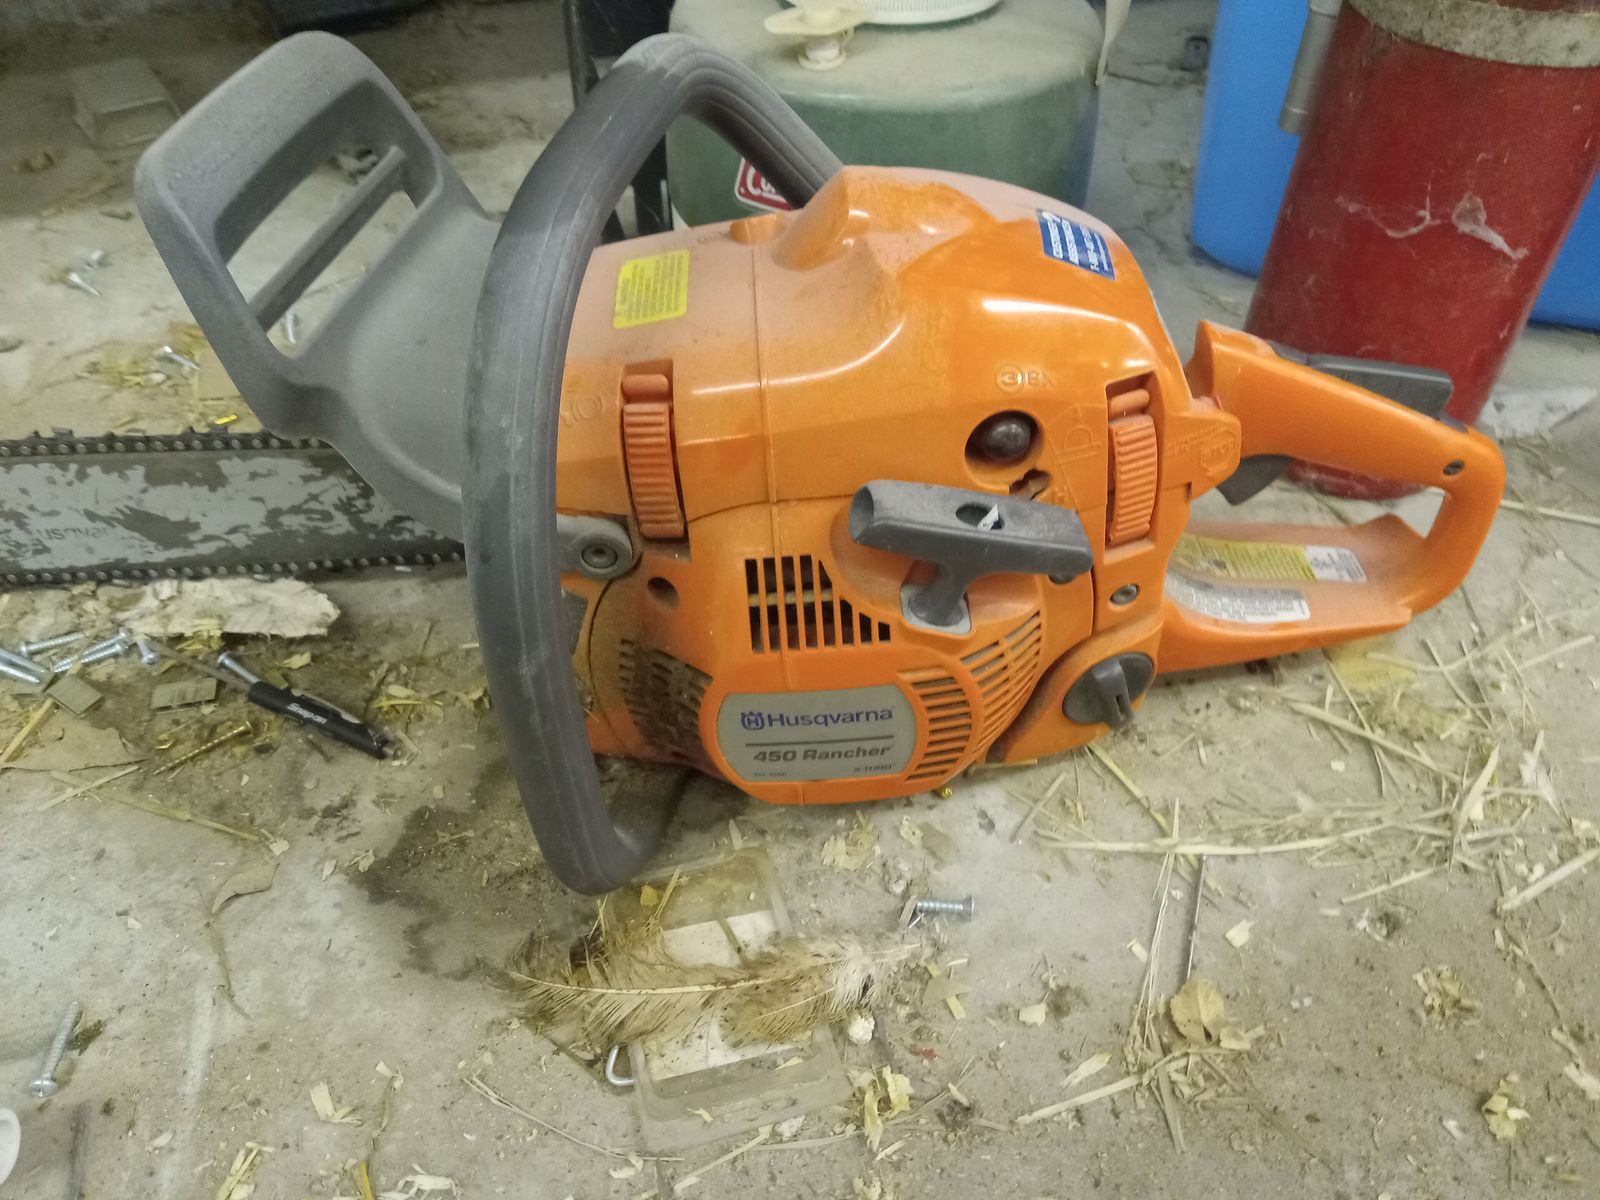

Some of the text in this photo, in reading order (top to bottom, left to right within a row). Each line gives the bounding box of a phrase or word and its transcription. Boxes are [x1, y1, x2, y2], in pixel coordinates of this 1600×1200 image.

[767, 708, 893, 728] Husqvarna
[753, 746, 891, 762] 450 Rancher
